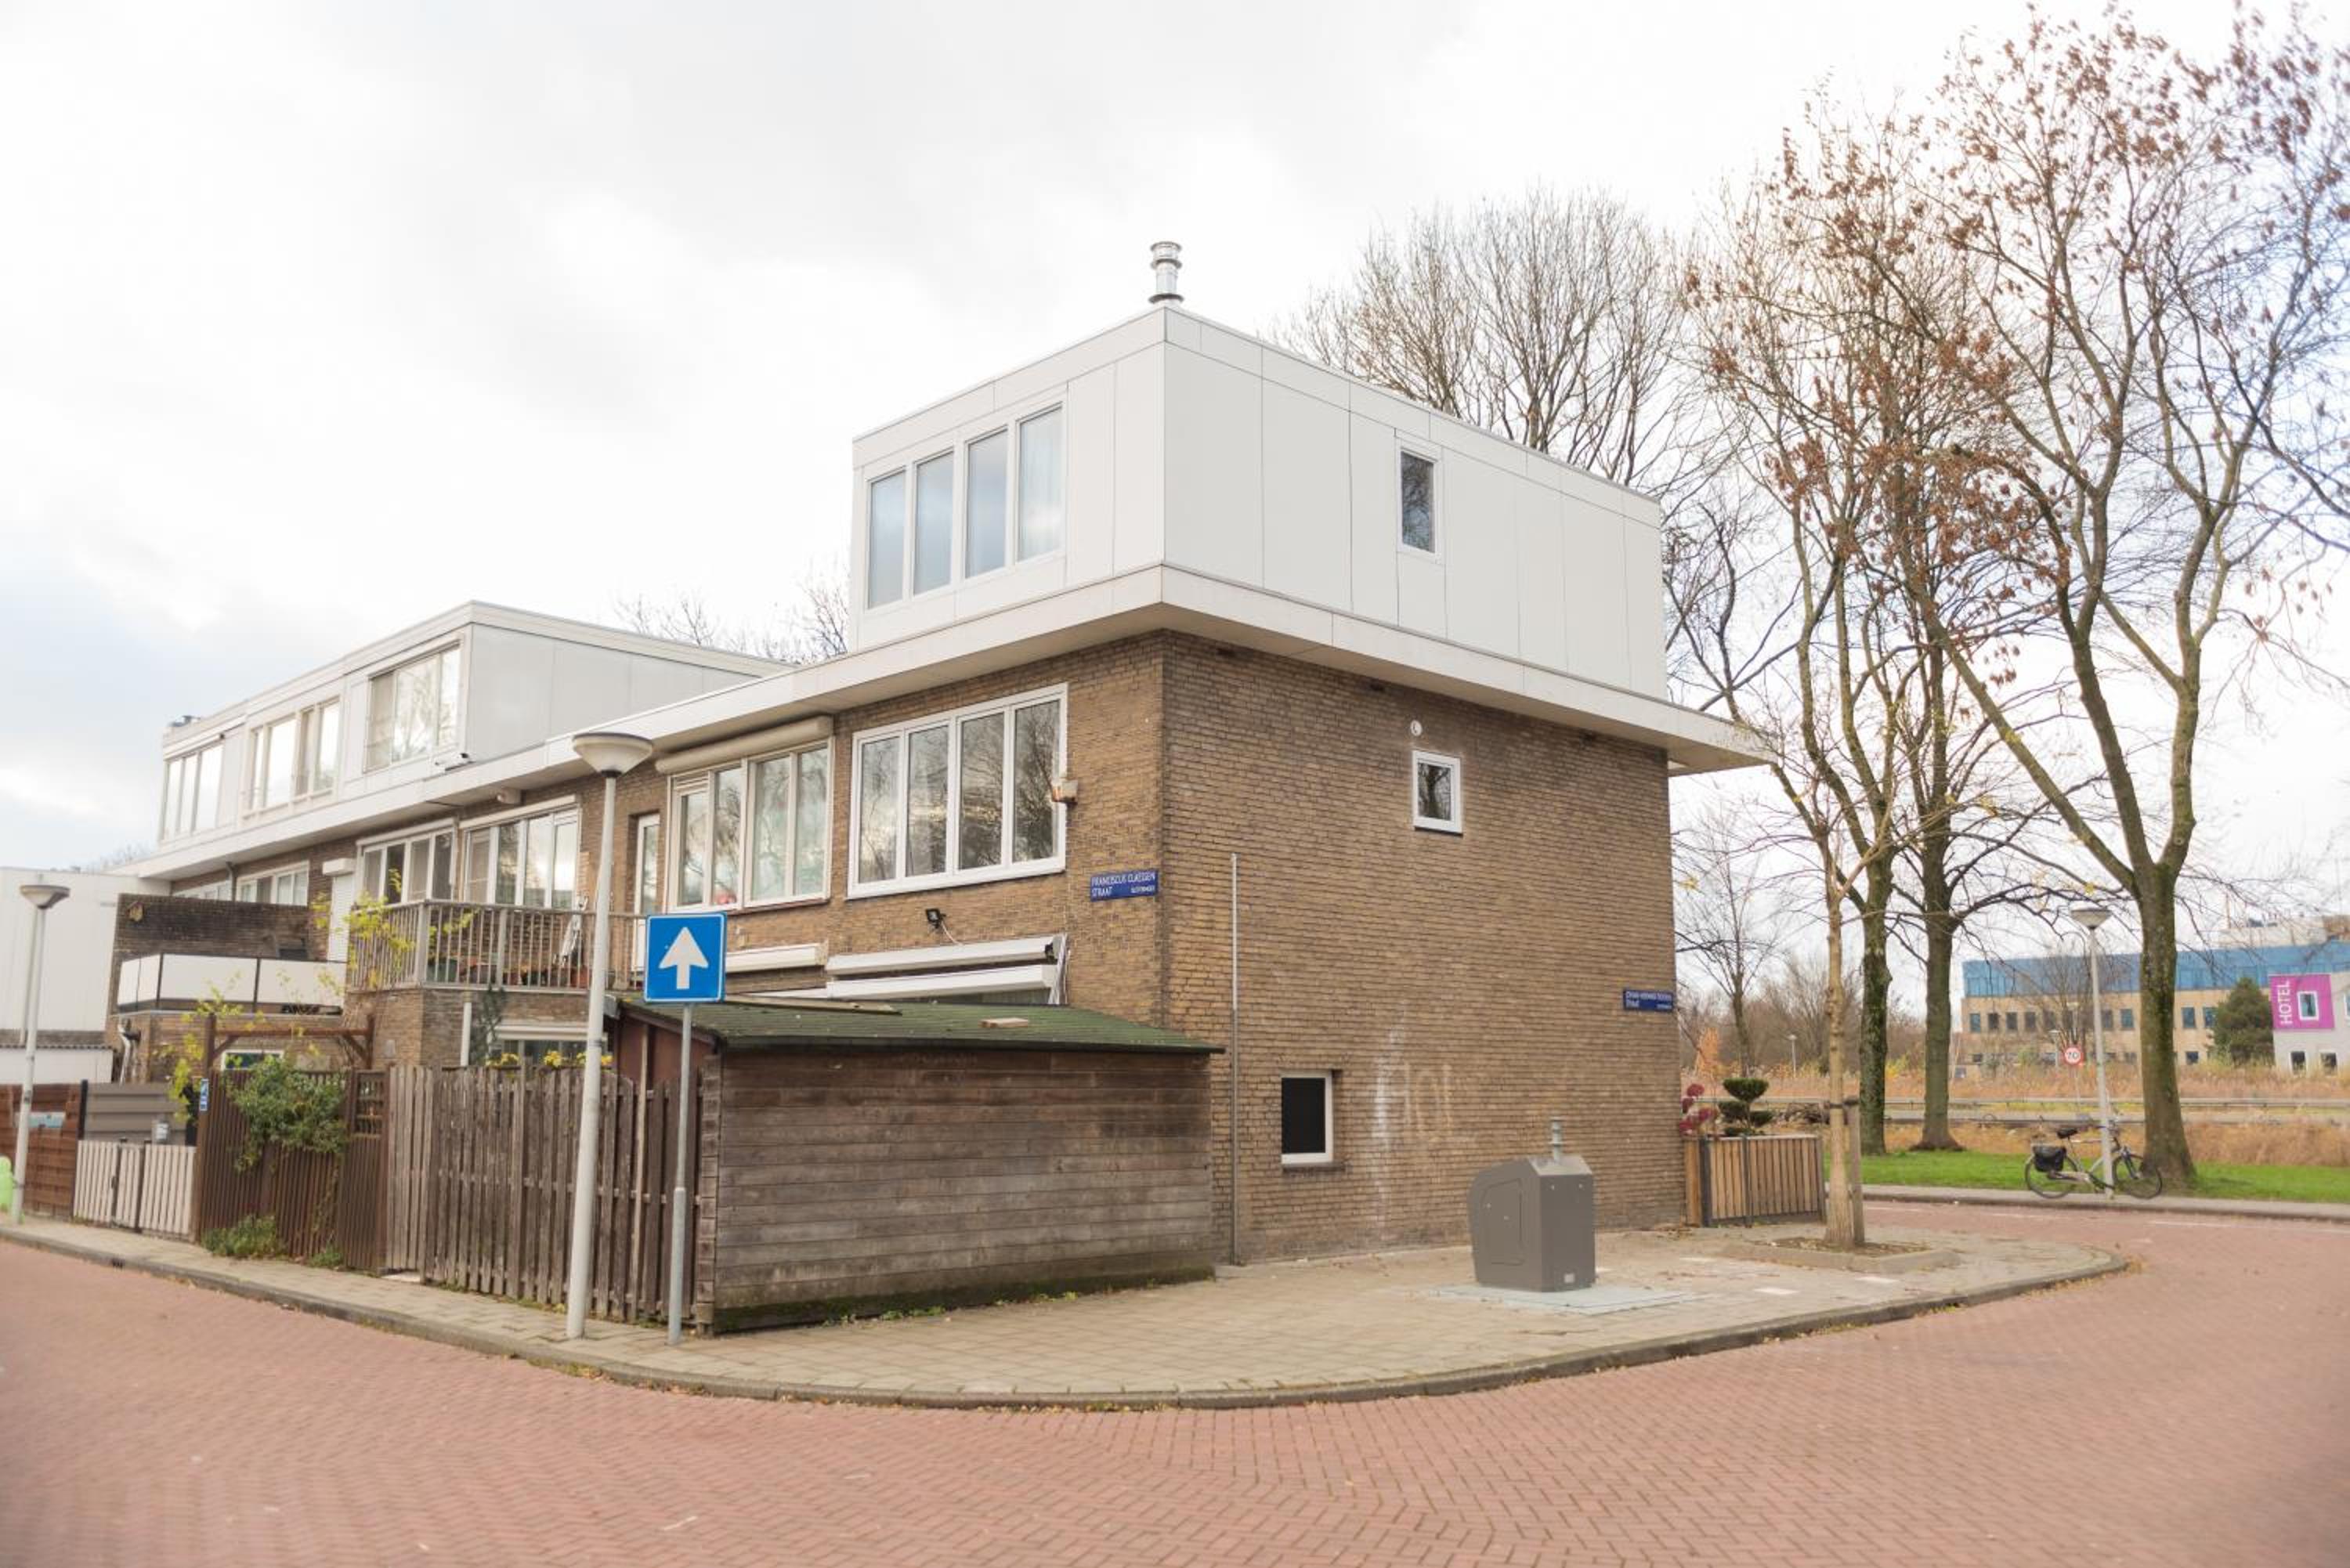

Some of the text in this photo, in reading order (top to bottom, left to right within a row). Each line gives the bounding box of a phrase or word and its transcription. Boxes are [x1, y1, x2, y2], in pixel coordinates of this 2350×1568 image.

[1091, 874, 1127, 887] FRANCISCUS
[1091, 886, 1113, 897] STRAAT
[2276, 979, 2293, 1024] HOTEL
